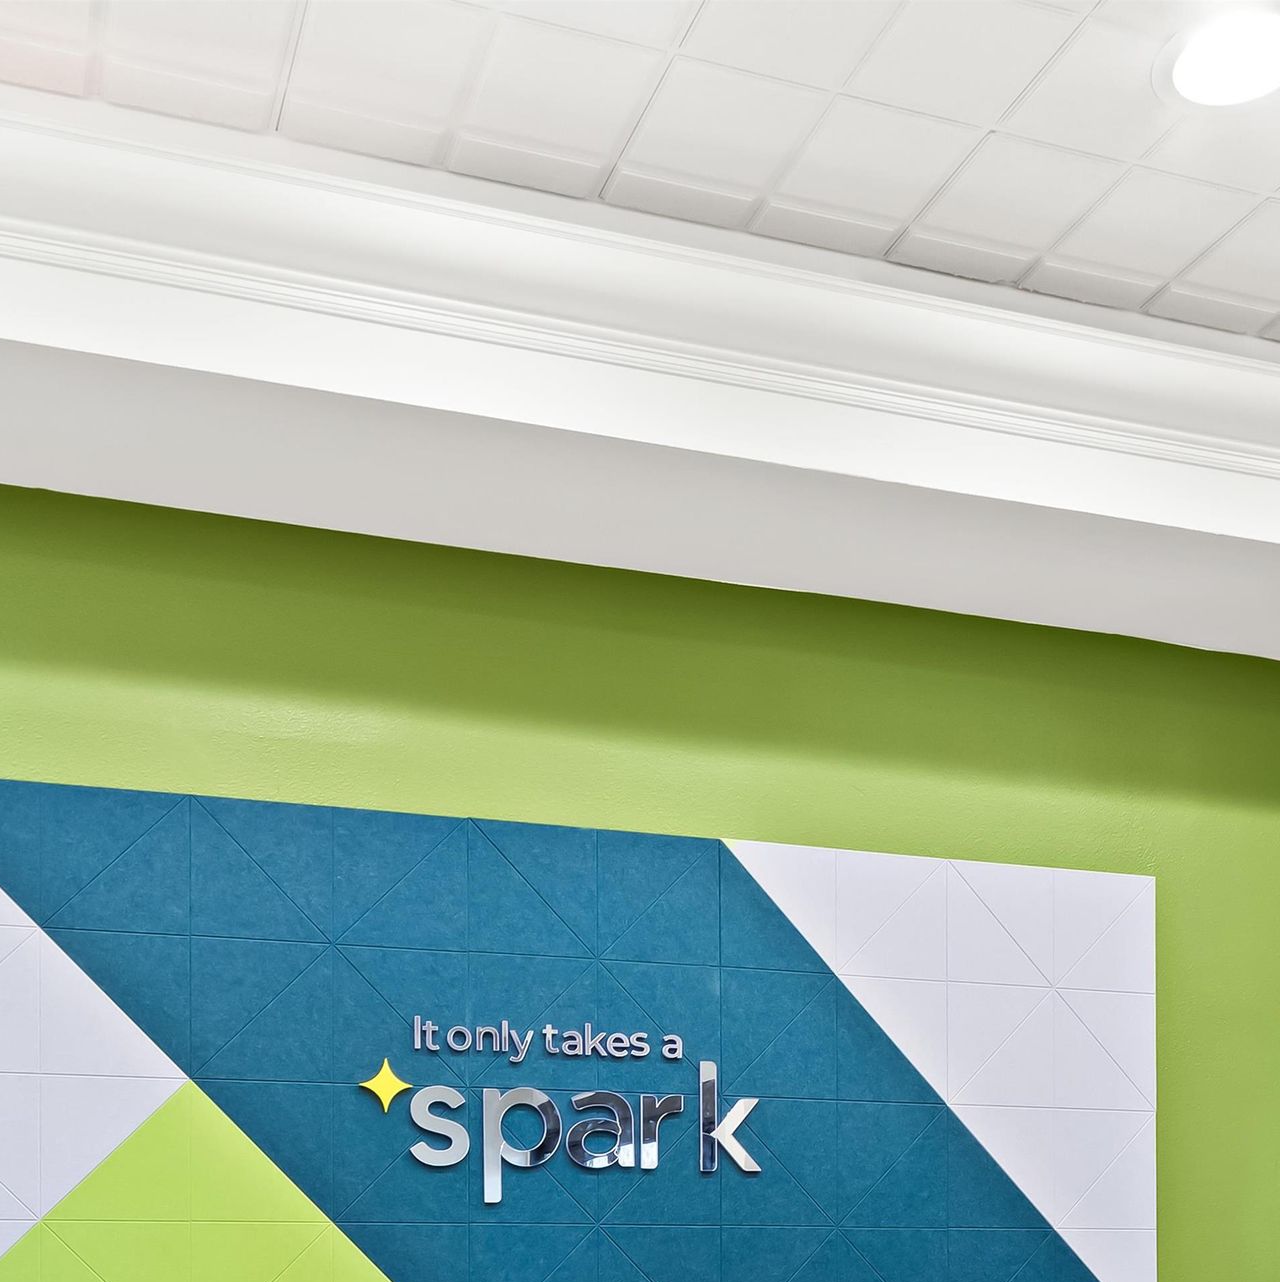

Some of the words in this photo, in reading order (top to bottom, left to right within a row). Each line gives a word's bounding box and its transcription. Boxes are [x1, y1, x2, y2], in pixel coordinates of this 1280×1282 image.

[413, 1015, 440, 1051] It
[446, 1020, 534, 1063] only
[542, 1023, 648, 1058] takes
[661, 1033, 684, 1059] a
[410, 1060, 762, 1204] spark
